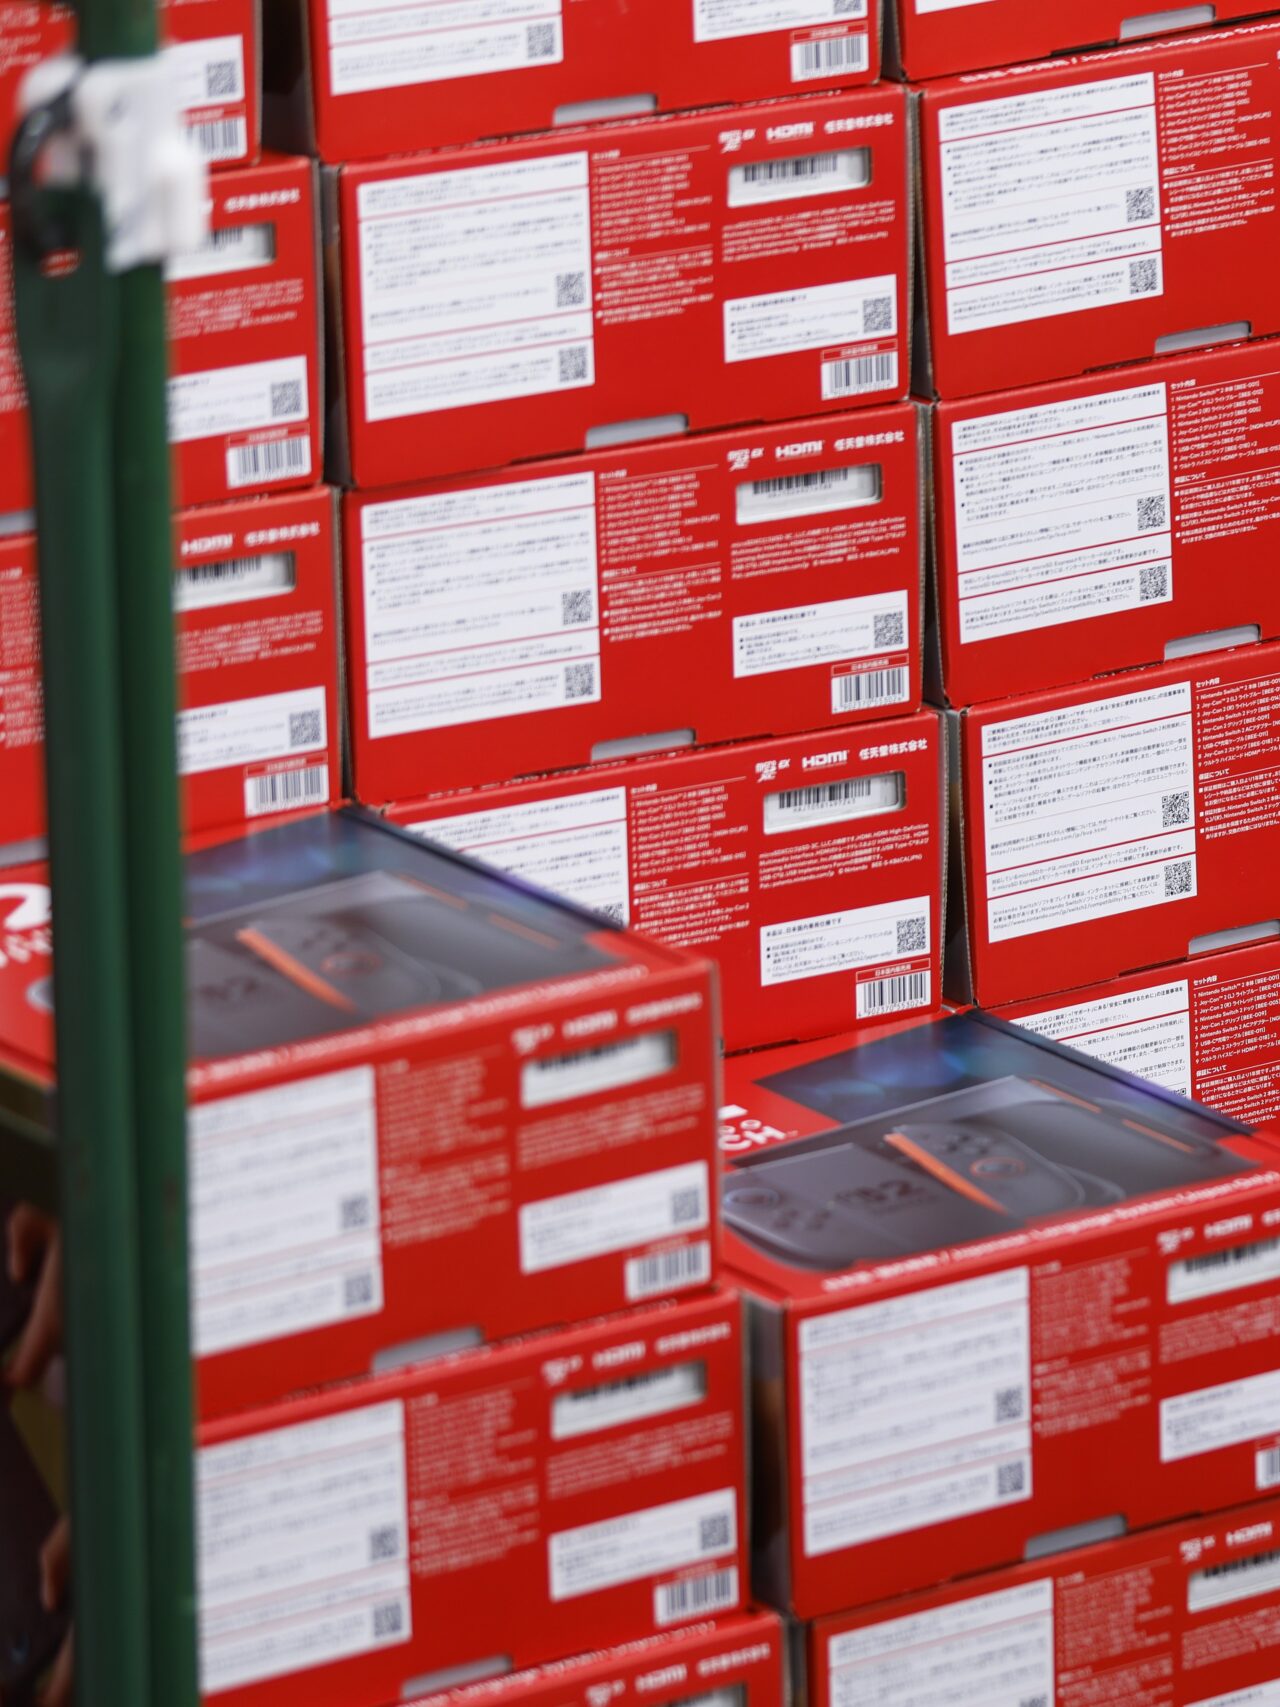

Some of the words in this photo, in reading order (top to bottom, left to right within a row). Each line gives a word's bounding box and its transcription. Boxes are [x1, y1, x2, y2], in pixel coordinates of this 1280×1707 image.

[768, 121, 812, 138] HDMI
[776, 440, 822, 457] HDMI
[803, 750, 847, 768] HDMI
[1198, 988, 1220, 997] Nintendo
[867, 1004, 893, 1015] 902370
[897, 998, 923, 1010] 553024
[1199, 1004, 1219, 1014] Joy-Con
[1200, 1012, 1221, 1022] Nintendo
[1223, 1008, 1239, 1016] Switch
